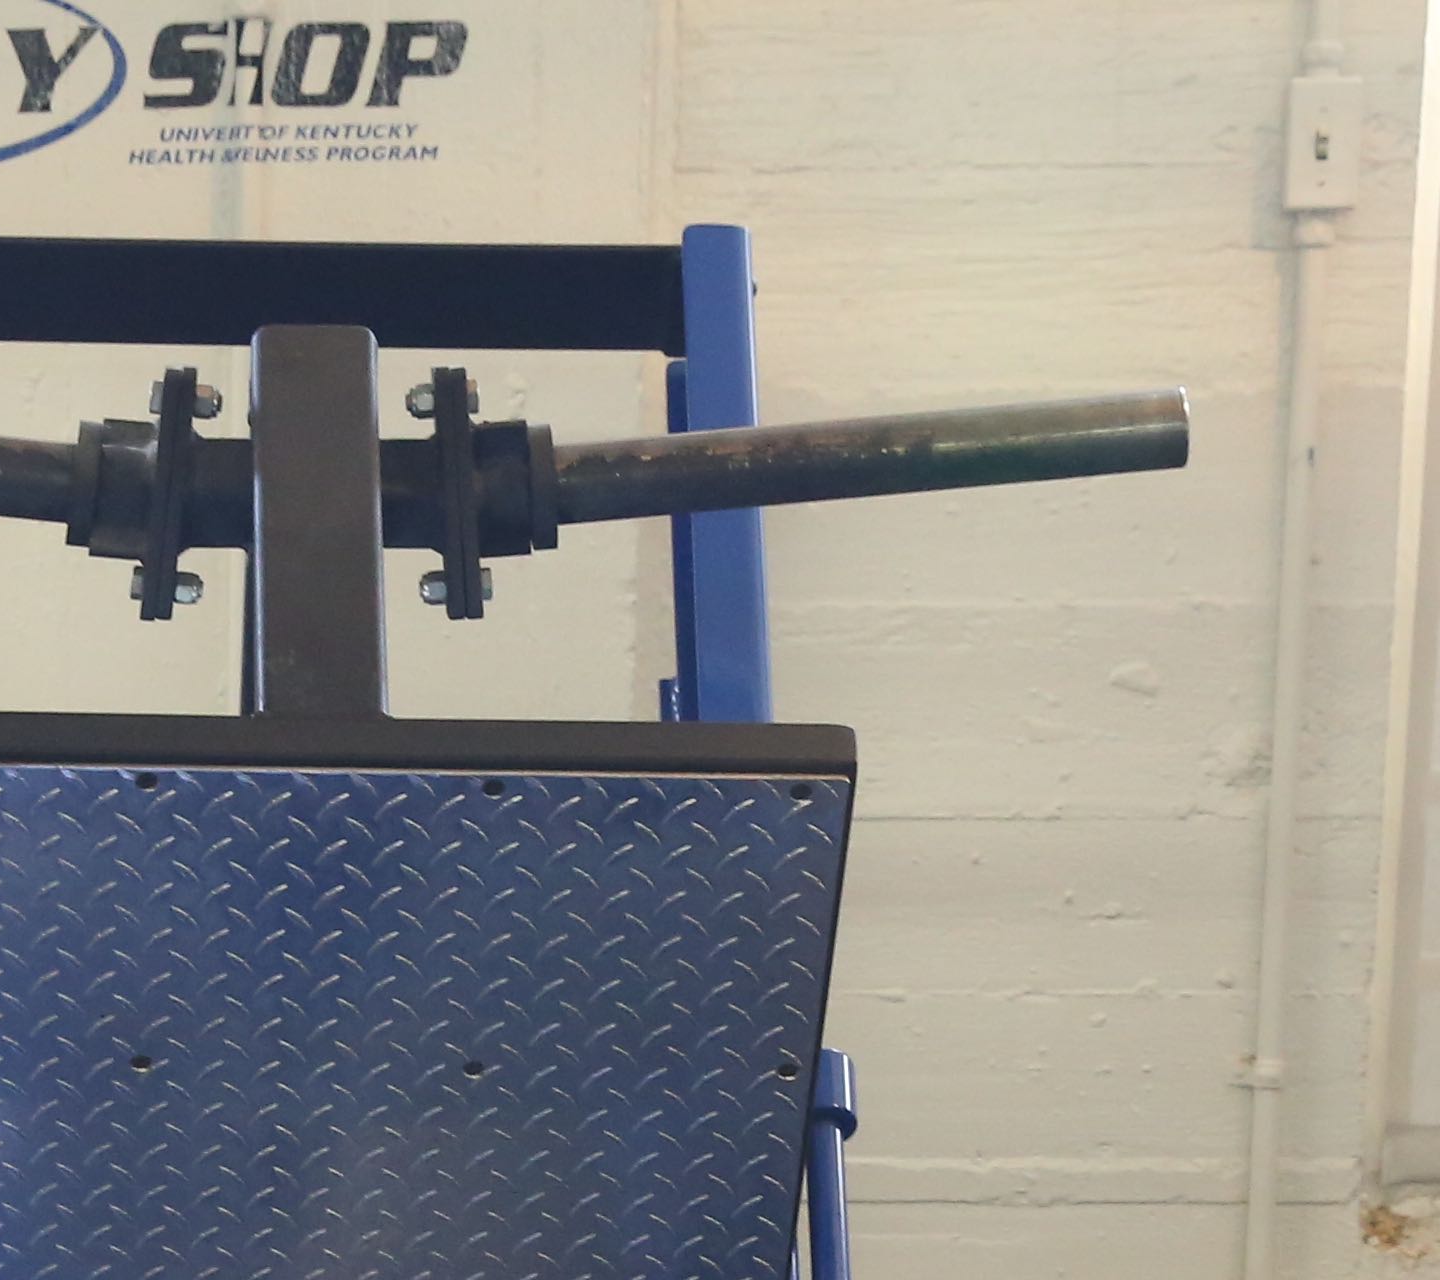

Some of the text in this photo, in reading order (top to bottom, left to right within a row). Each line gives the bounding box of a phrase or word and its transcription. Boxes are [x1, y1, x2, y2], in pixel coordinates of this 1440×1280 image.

[143, 16, 469, 108] SHOP
[258, 124, 289, 140] OF
[295, 123, 419, 140] KENTUCKY
[128, 148, 215, 165] HEALTH
[229, 146, 318, 163] WELNESS
[326, 145, 439, 161] PROGRAM
